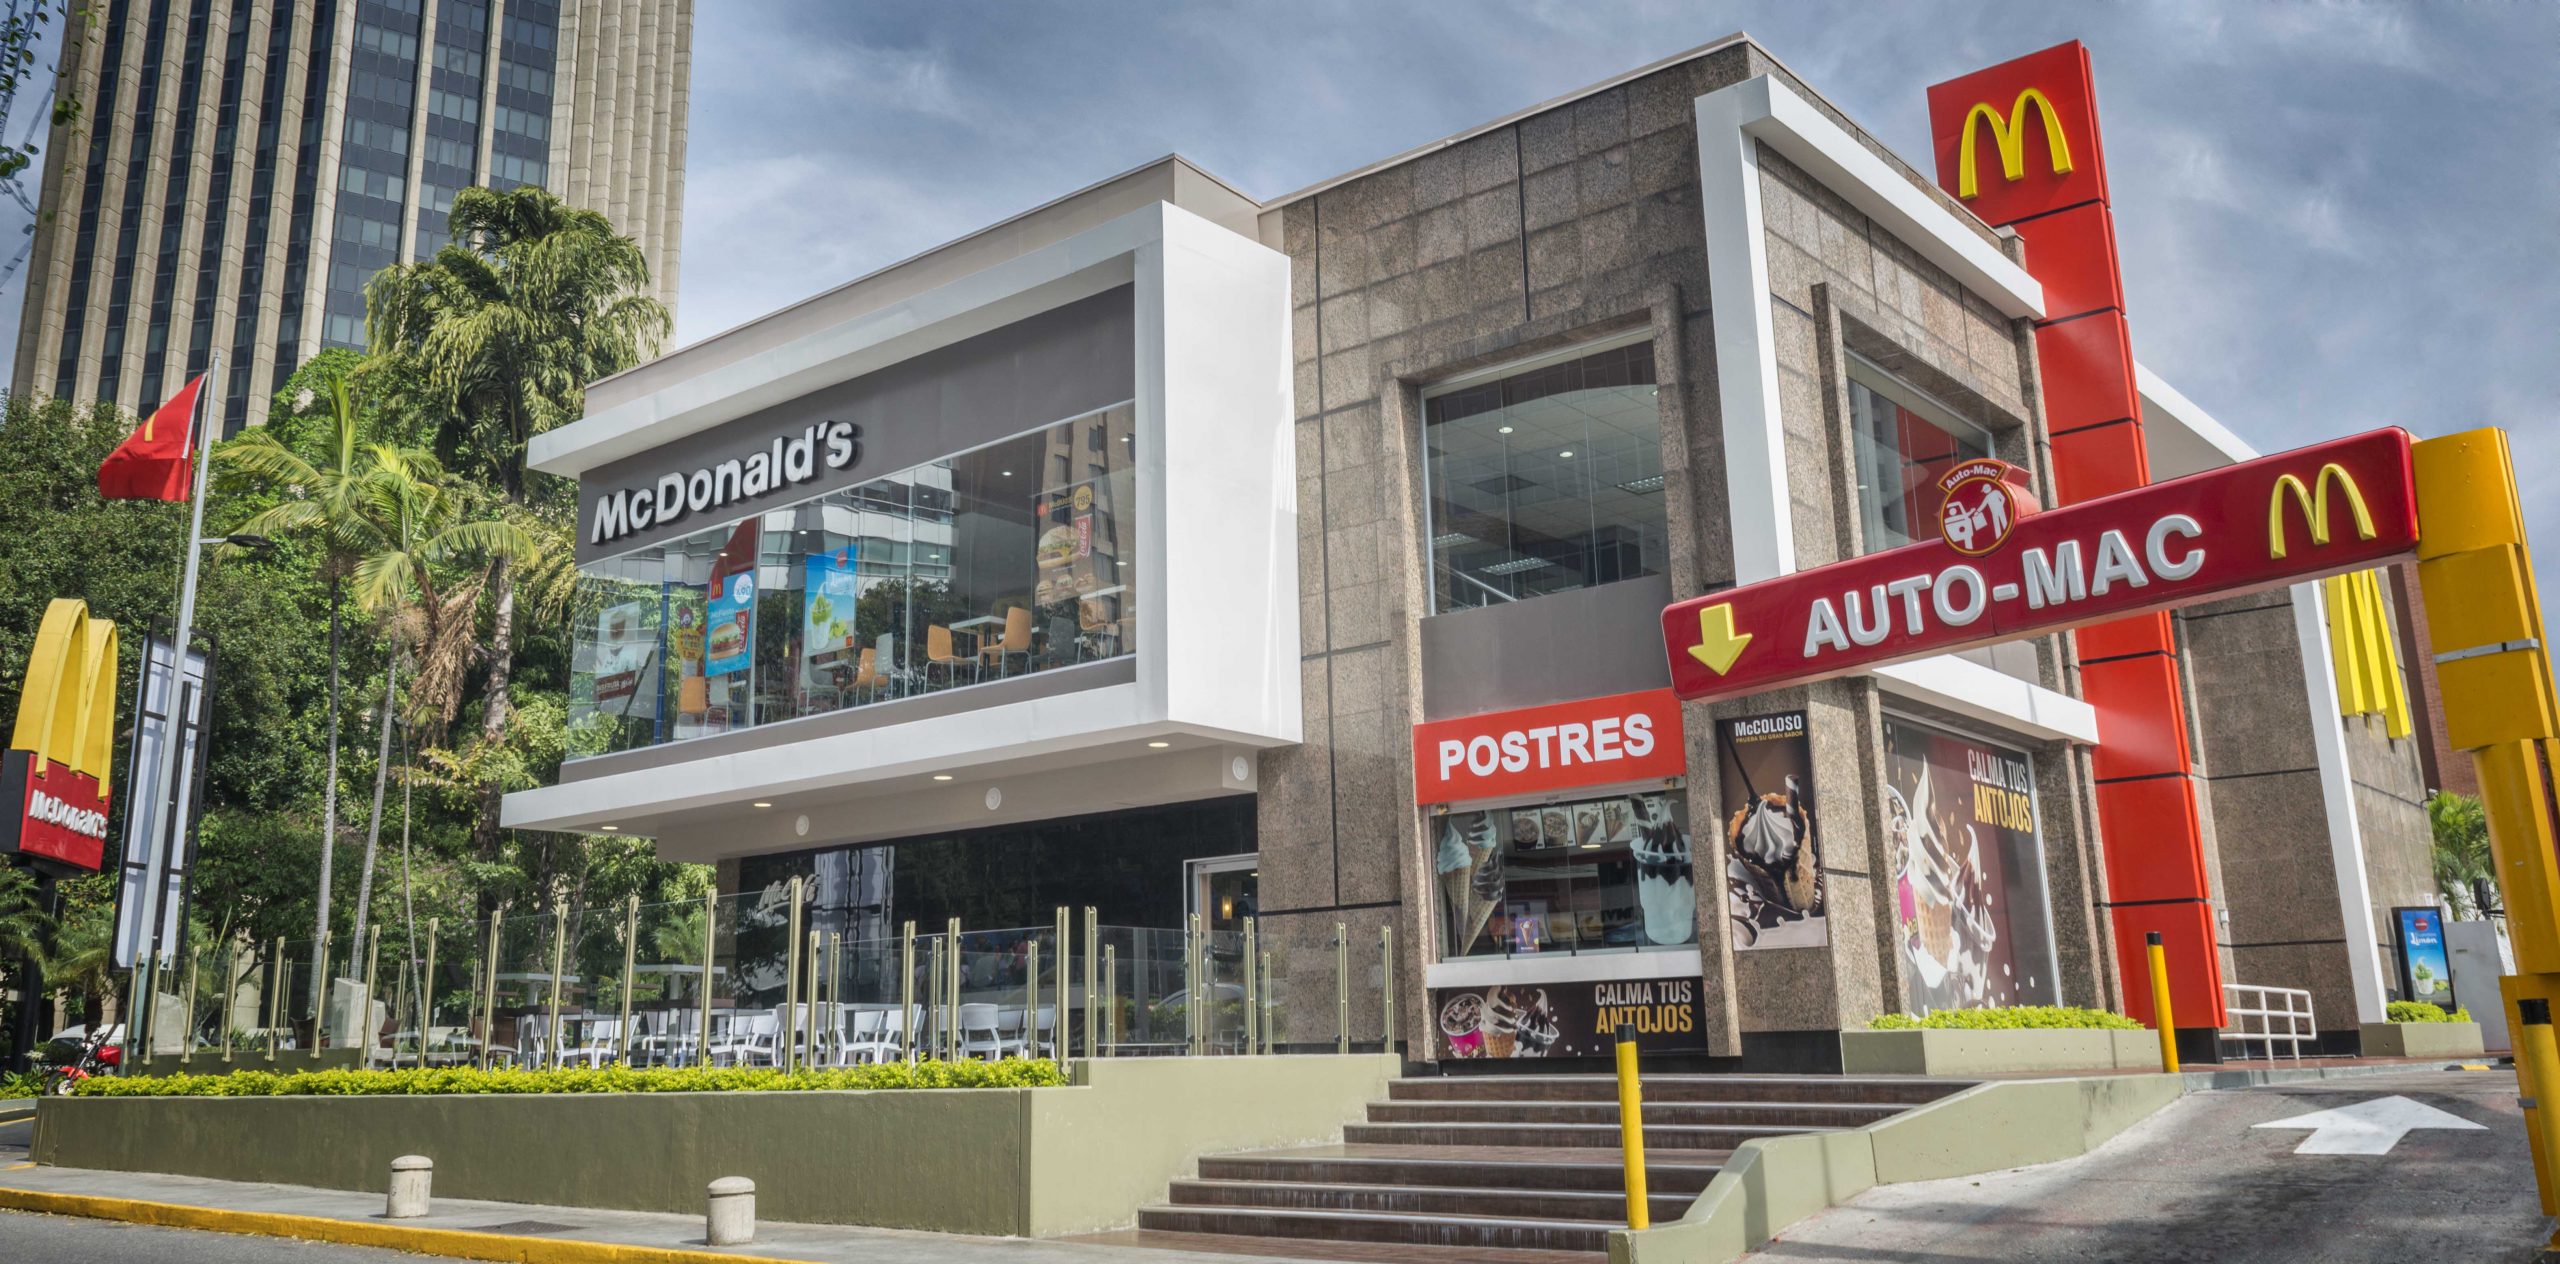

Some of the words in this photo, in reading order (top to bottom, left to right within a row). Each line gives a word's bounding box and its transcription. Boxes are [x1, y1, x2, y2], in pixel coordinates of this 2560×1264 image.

[591, 421, 853, 545] McDonald's
[1945, 465, 1998, 489] Auto-Mac
[1803, 514, 2206, 658] AUTO-MAC
[1439, 713, 1655, 781] POSTRES
[1734, 715, 1802, 736] McCOLOSO
[1967, 748, 2007, 788] CALMA
[2005, 759, 2028, 794] TUS
[1973, 783, 2033, 834] ANTOJOS
[1595, 982, 1653, 1006] CALMA
[1657, 980, 1693, 1004] TUS
[1595, 1003, 1694, 1034] ANTOJOS
